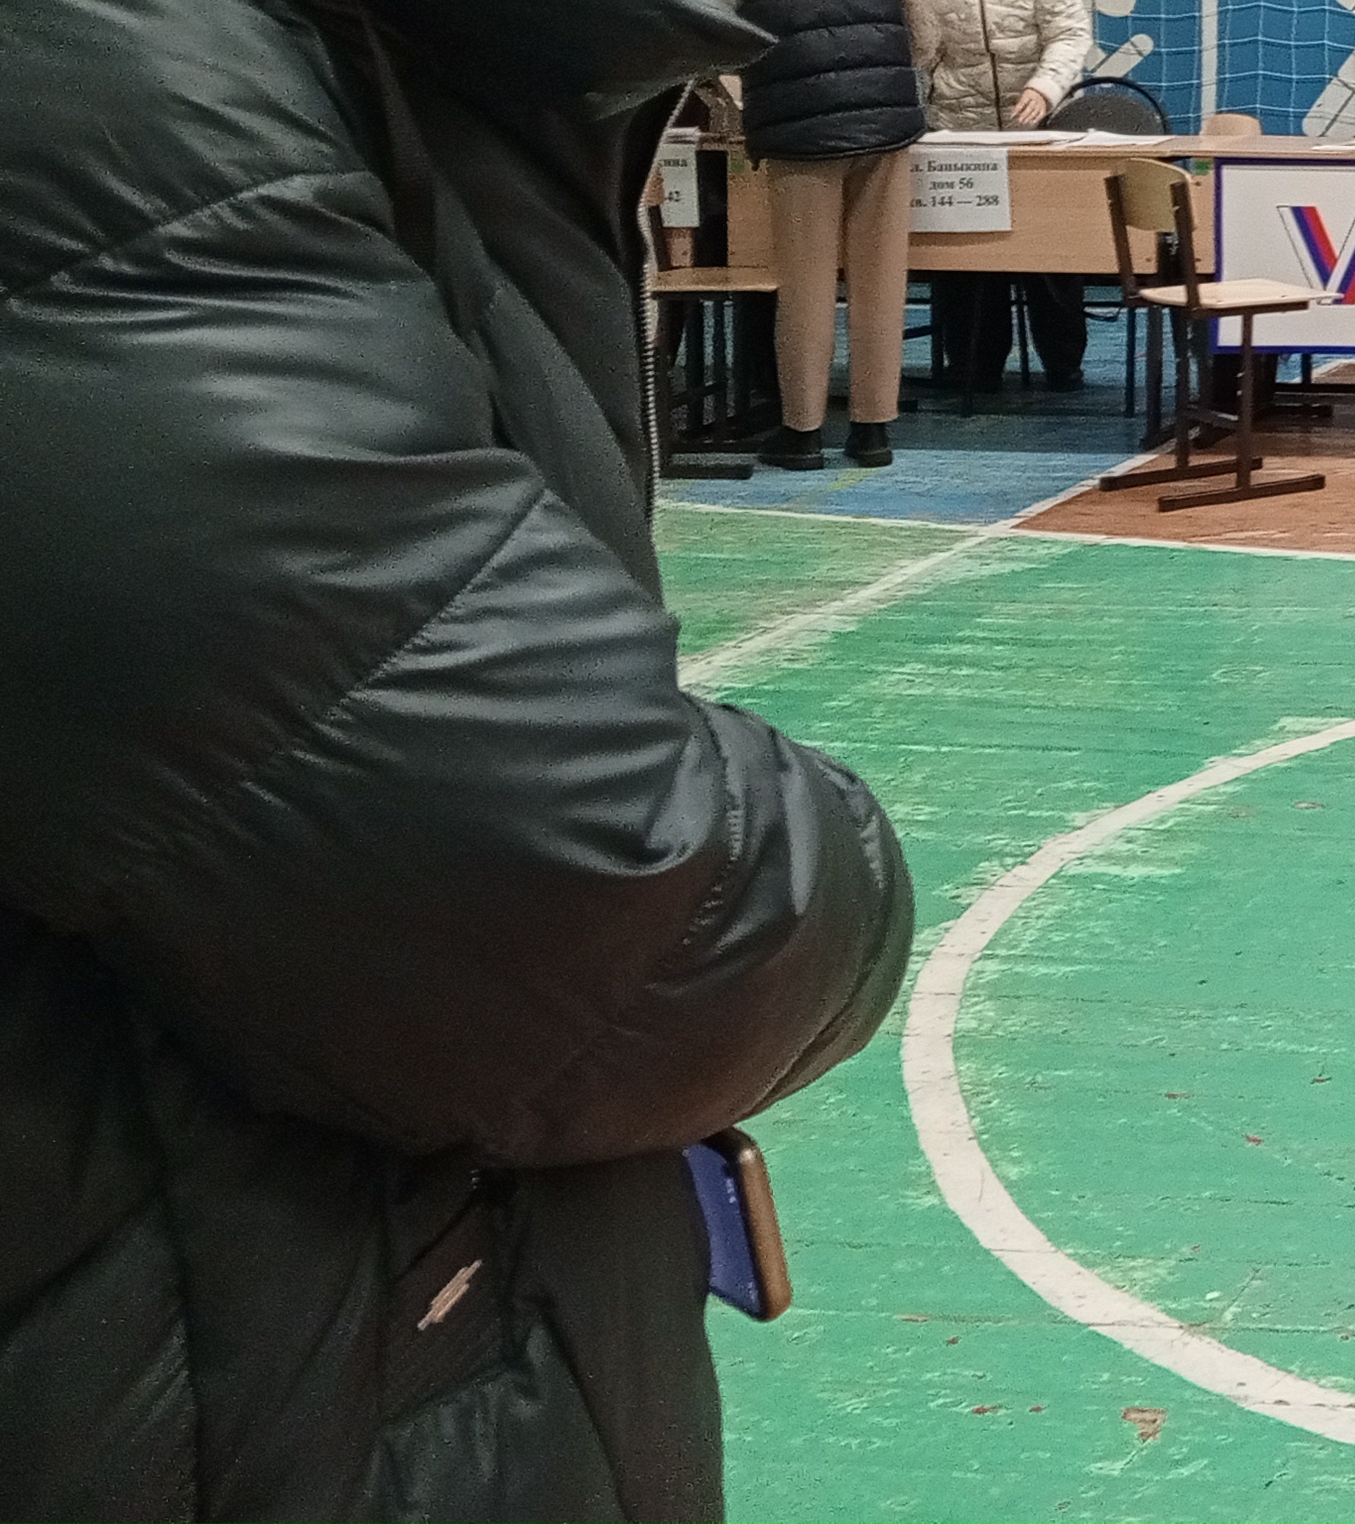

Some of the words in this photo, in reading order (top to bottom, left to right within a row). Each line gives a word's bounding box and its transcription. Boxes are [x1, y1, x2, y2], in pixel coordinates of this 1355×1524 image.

[927, 160, 1000, 173] Баныкина
[928, 180, 956, 191] дом
[958, 177, 974, 190] 56
[930, 195, 954, 208] 144
[975, 195, 1000, 207] 288
